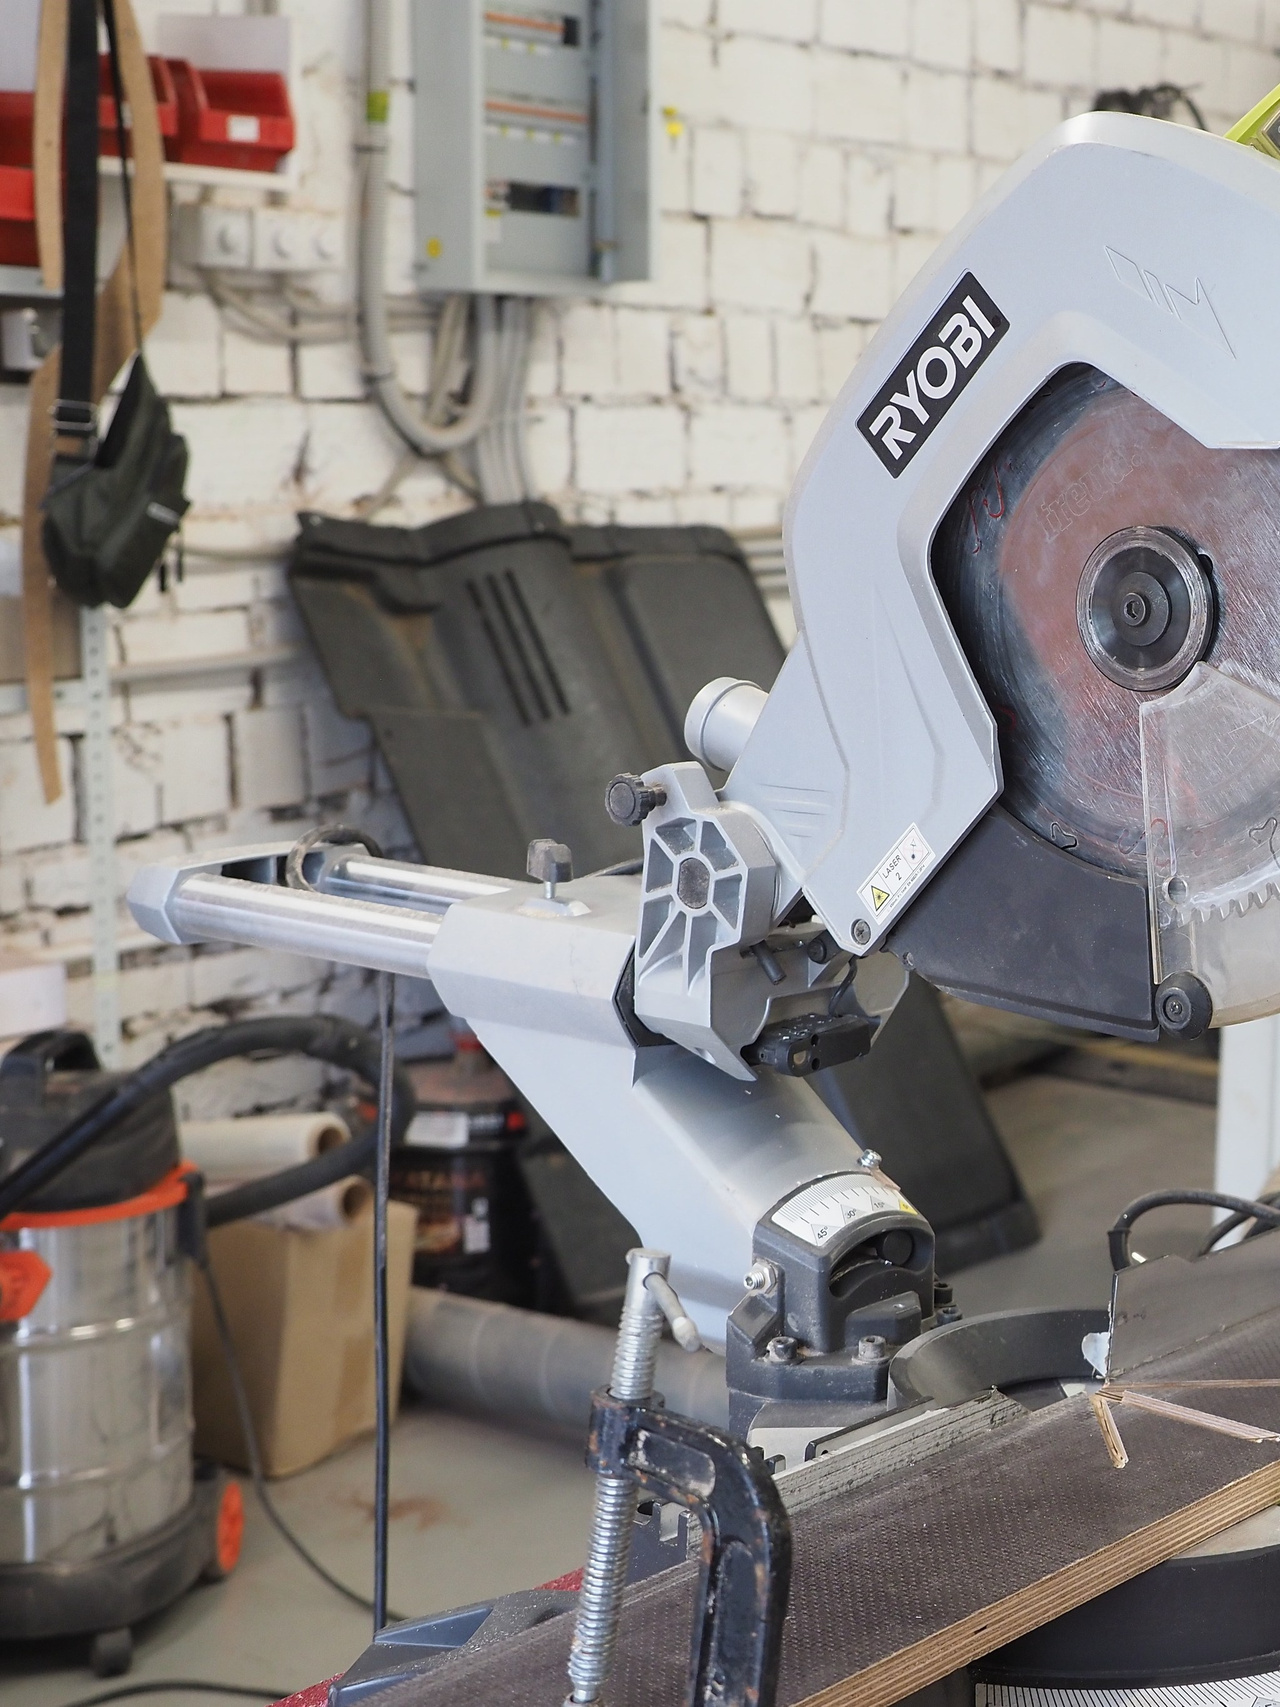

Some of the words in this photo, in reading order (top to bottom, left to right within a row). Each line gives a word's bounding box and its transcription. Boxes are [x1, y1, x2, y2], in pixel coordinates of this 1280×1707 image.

[868, 294, 996, 461] RYOBI
[882, 854, 902, 879] LASER
[895, 872, 902, 881] 2
